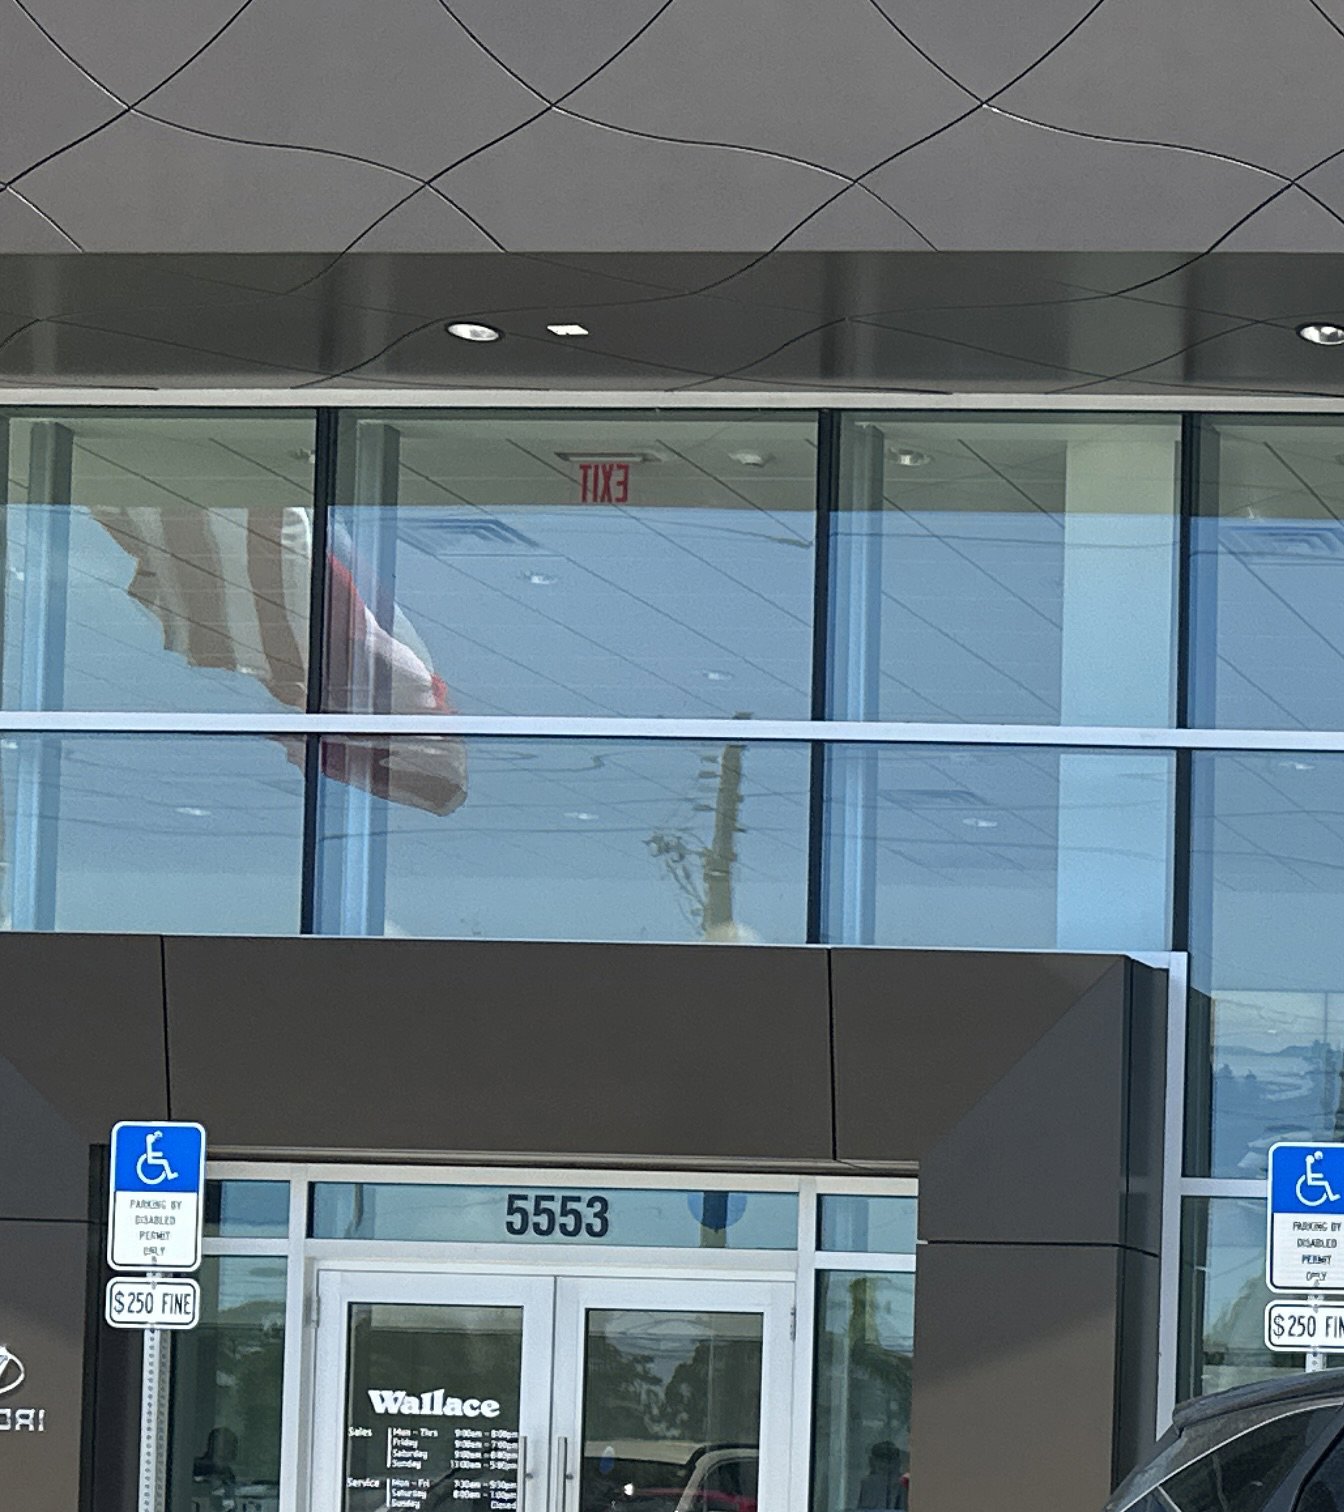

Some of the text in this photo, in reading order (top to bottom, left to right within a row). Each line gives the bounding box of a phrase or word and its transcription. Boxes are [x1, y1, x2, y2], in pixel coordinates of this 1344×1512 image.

[506, 1194, 609, 1237] 5553
[114, 1290, 191, 1315] $250 FINE
[1273, 1313, 1316, 1339] $250
[368, 1389, 500, 1418] Wallace
[348, 1426, 373, 1437] Sales
[347, 1478, 380, 1488] Service
